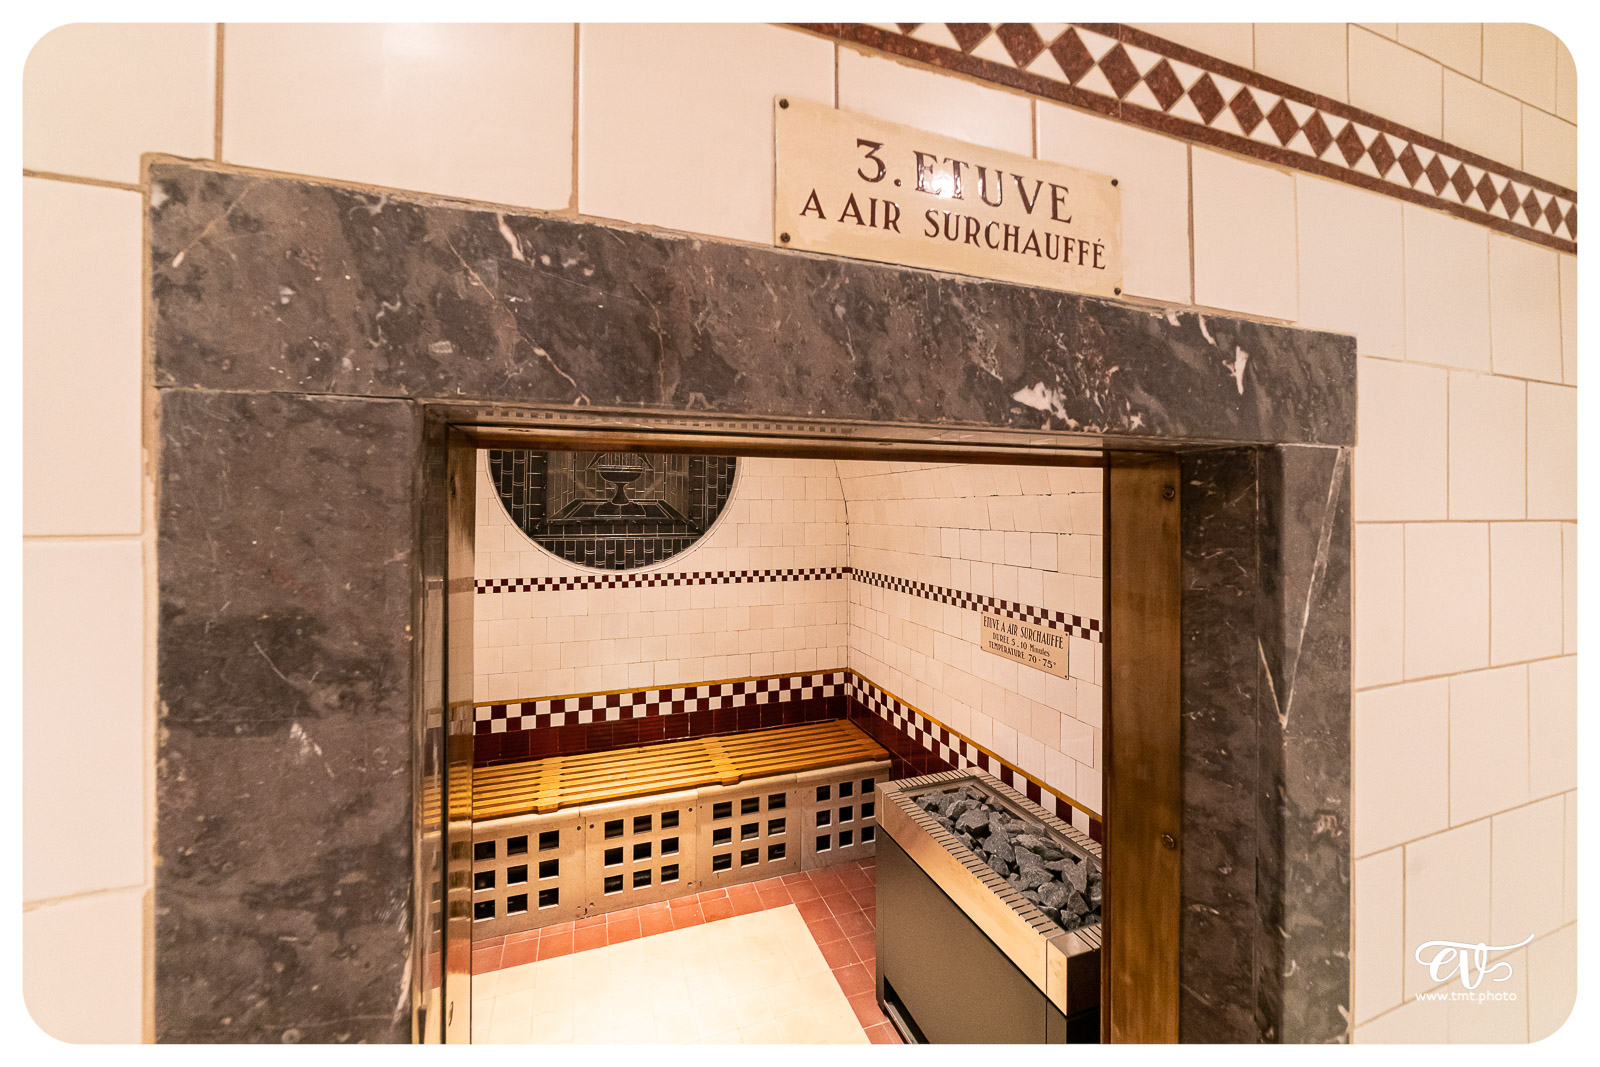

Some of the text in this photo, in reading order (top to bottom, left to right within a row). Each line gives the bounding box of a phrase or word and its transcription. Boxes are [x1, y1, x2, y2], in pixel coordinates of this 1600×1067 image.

[856, 138, 1072, 224] 3. ETUVE
[800, 188, 1106, 270] A AIR SURCHAUFFÉ
[983, 616, 999, 631] ETUVE
[1000, 622, 1006, 633] A
[1007, 623, 1018, 636] AIR
